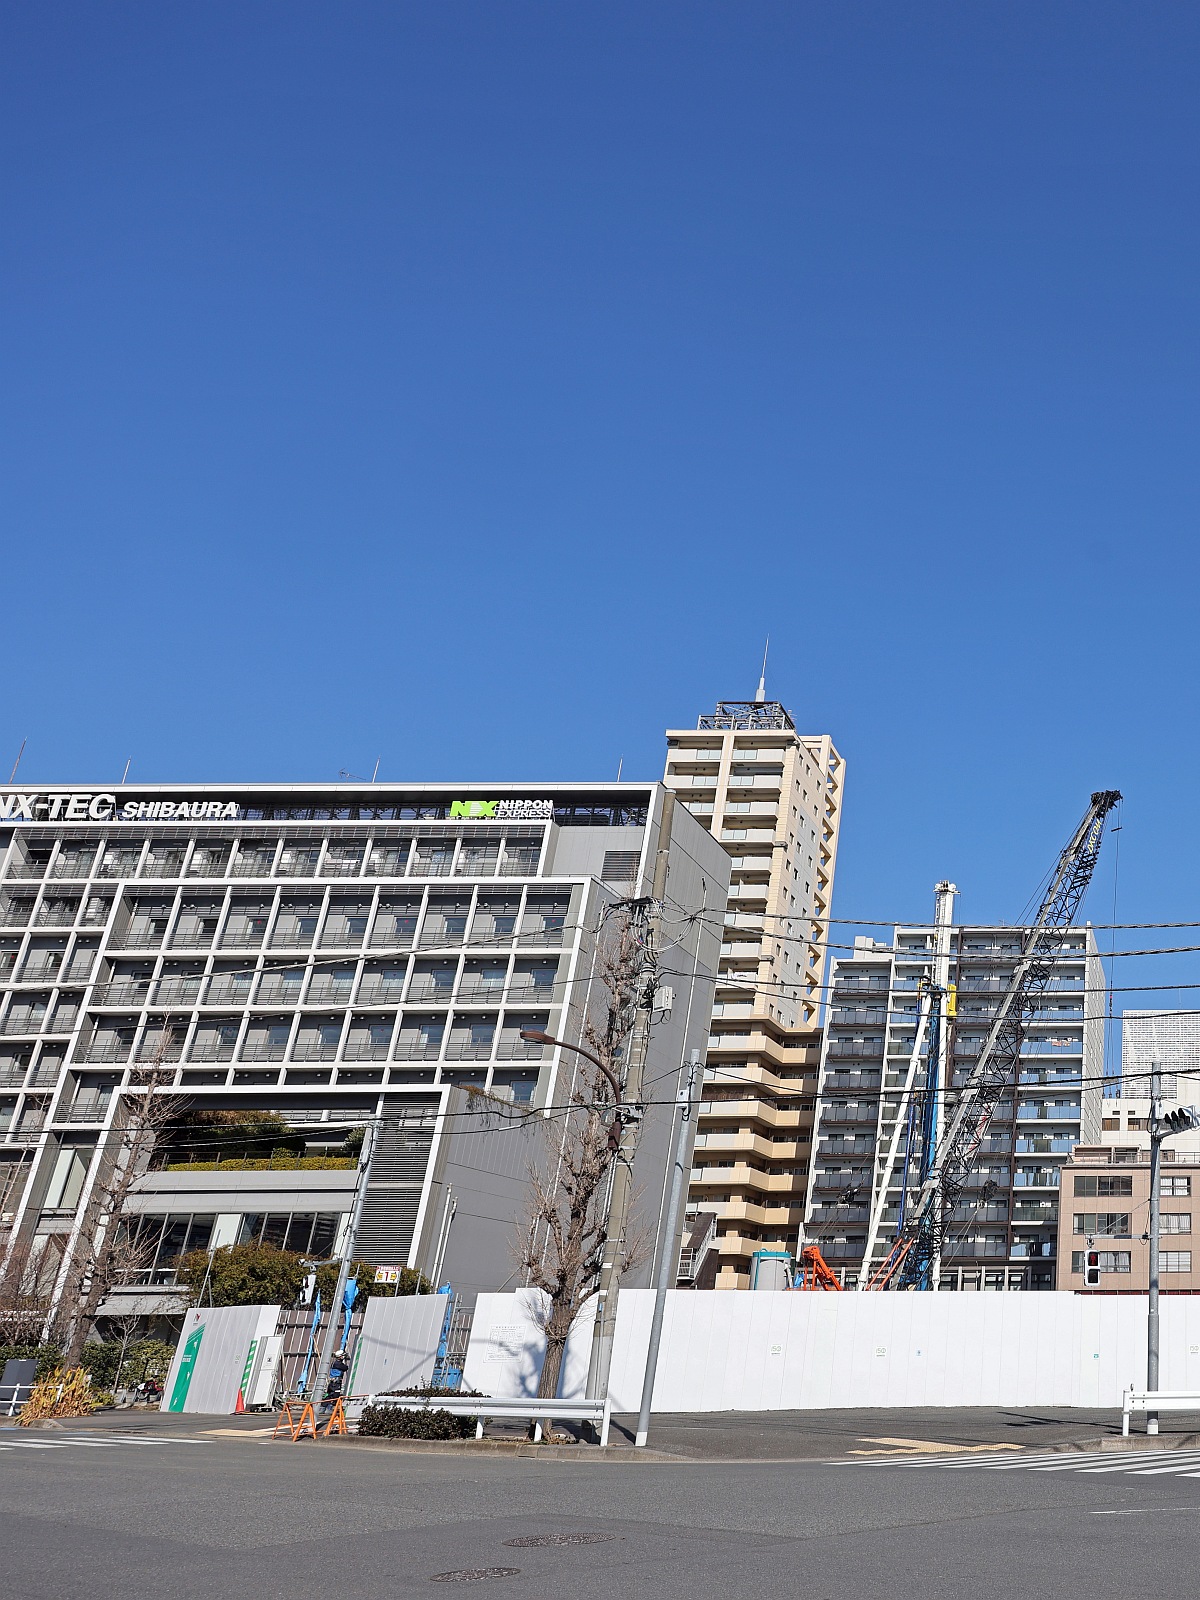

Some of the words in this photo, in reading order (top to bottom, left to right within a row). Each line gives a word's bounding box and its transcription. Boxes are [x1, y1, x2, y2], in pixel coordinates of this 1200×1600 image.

[122, 801, 239, 818] SHIBAURA
[450, 801, 499, 816] NX
[500, 800, 553, 809] NIPPON
[497, 809, 551, 817] EXPRESS
